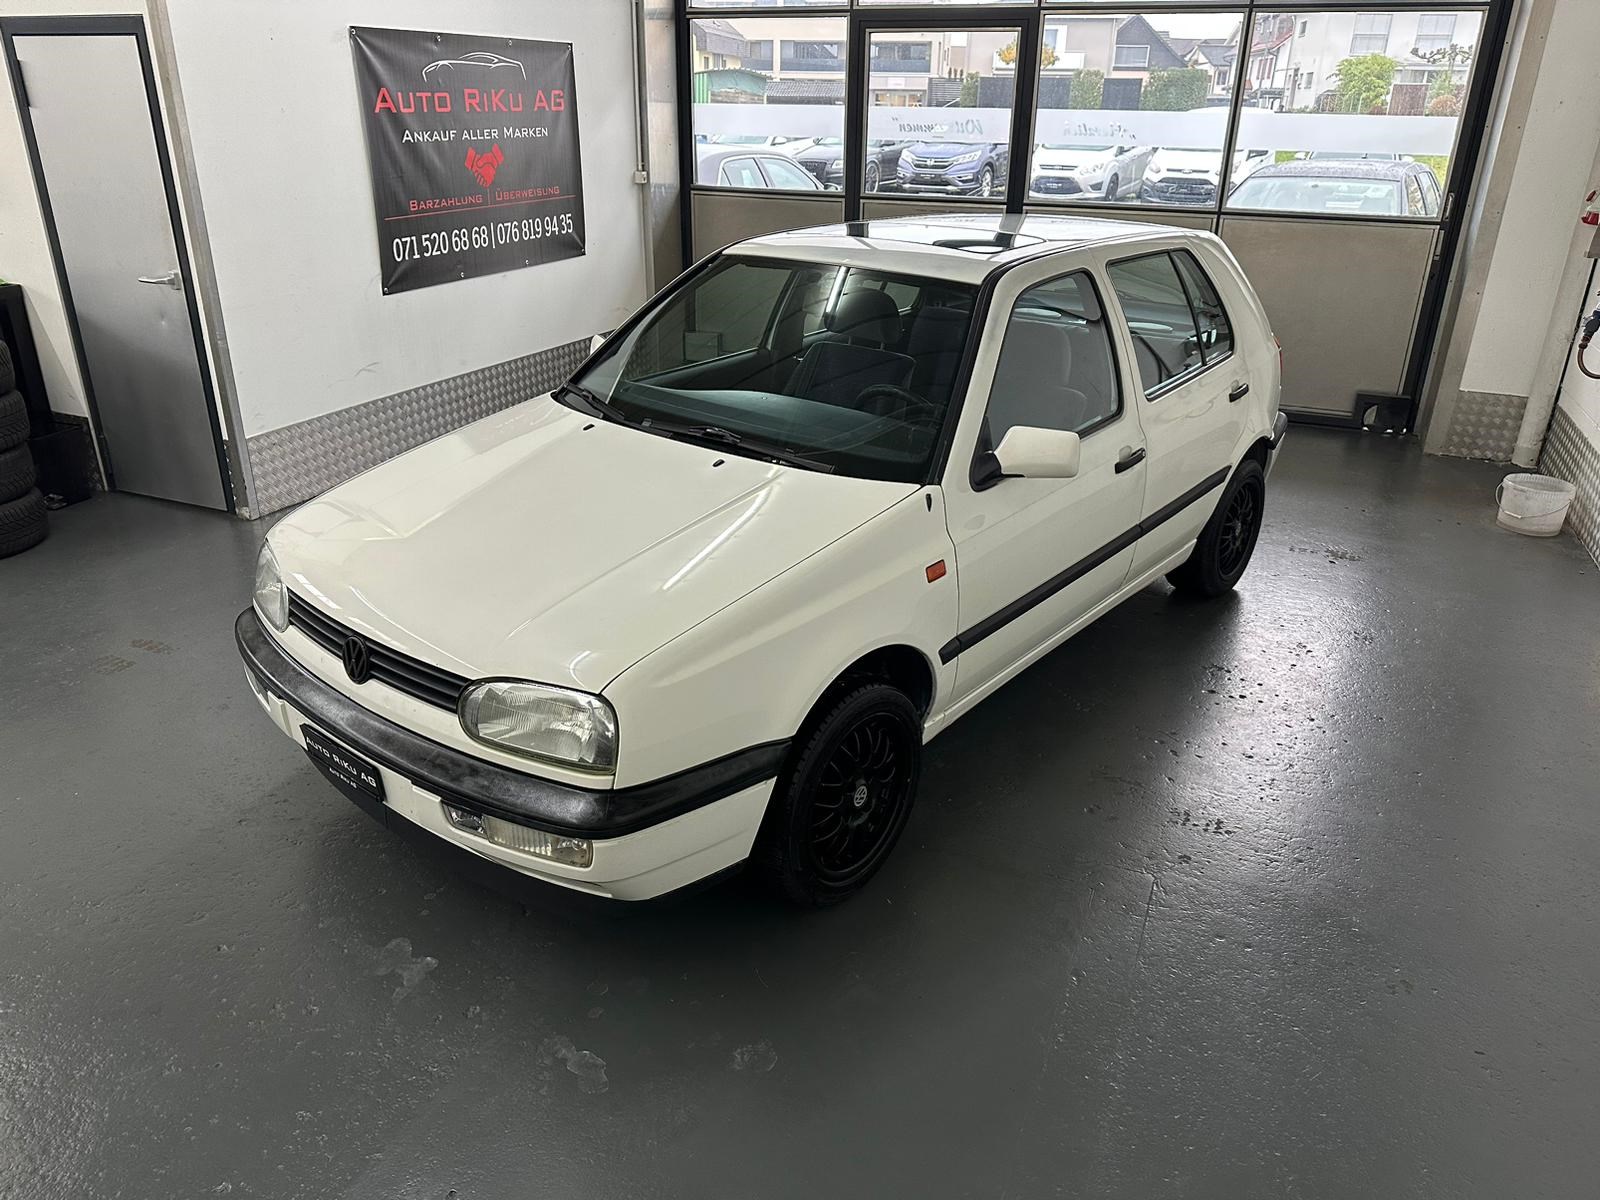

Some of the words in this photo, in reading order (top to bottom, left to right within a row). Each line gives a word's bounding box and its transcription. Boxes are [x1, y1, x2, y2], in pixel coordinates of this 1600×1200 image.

[374, 87, 451, 113] AUTO
[534, 89, 565, 112] AG
[402, 129, 457, 143] ANKAUF
[462, 128, 499, 140] ALLER
[503, 126, 549, 138] MARKEN
[409, 194, 483, 211] BARZAHLUNG
[495, 185, 560, 201] ÜBERWEISUNG
[392, 236, 420, 262] 071
[422, 231, 449, 257] 520
[451, 229, 469, 252] 68
[471, 225, 489, 249] 68
[497, 220, 520, 245] 076
[522, 217, 542, 240] 819
[544, 215, 559, 236] 94
[559, 213, 573, 234] 35
[361, 772, 377, 788] AG
